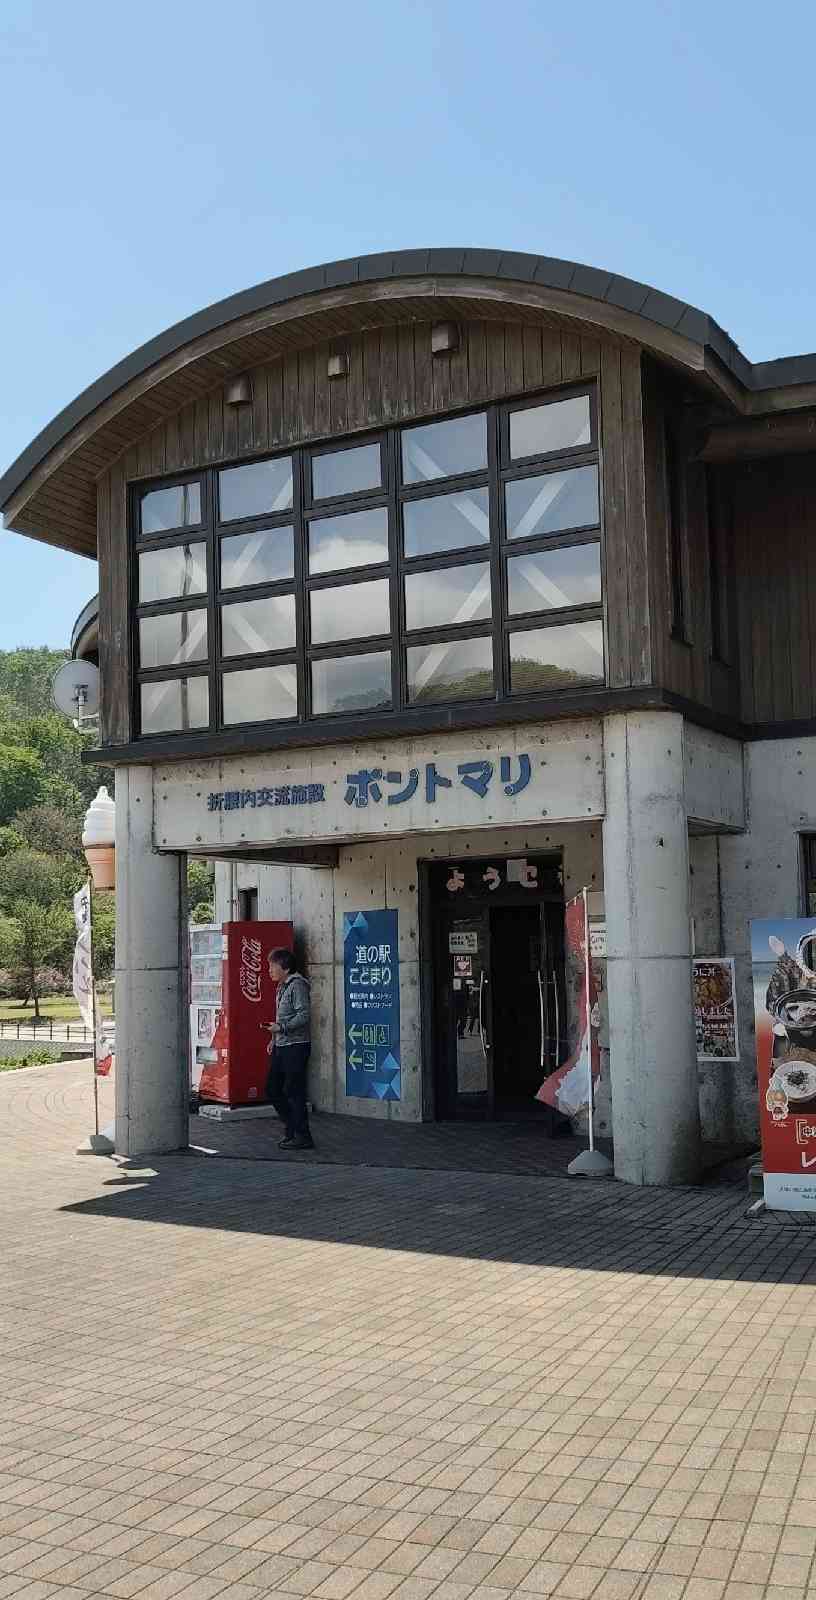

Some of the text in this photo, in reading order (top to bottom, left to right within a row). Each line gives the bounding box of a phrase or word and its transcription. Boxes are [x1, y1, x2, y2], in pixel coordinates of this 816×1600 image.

[345, 754, 532, 807] ポントマリ
[241, 936, 262, 1002] Coca-Cola
[356, 945, 391, 963] 道の駅
[350, 967, 391, 985] こどまり
